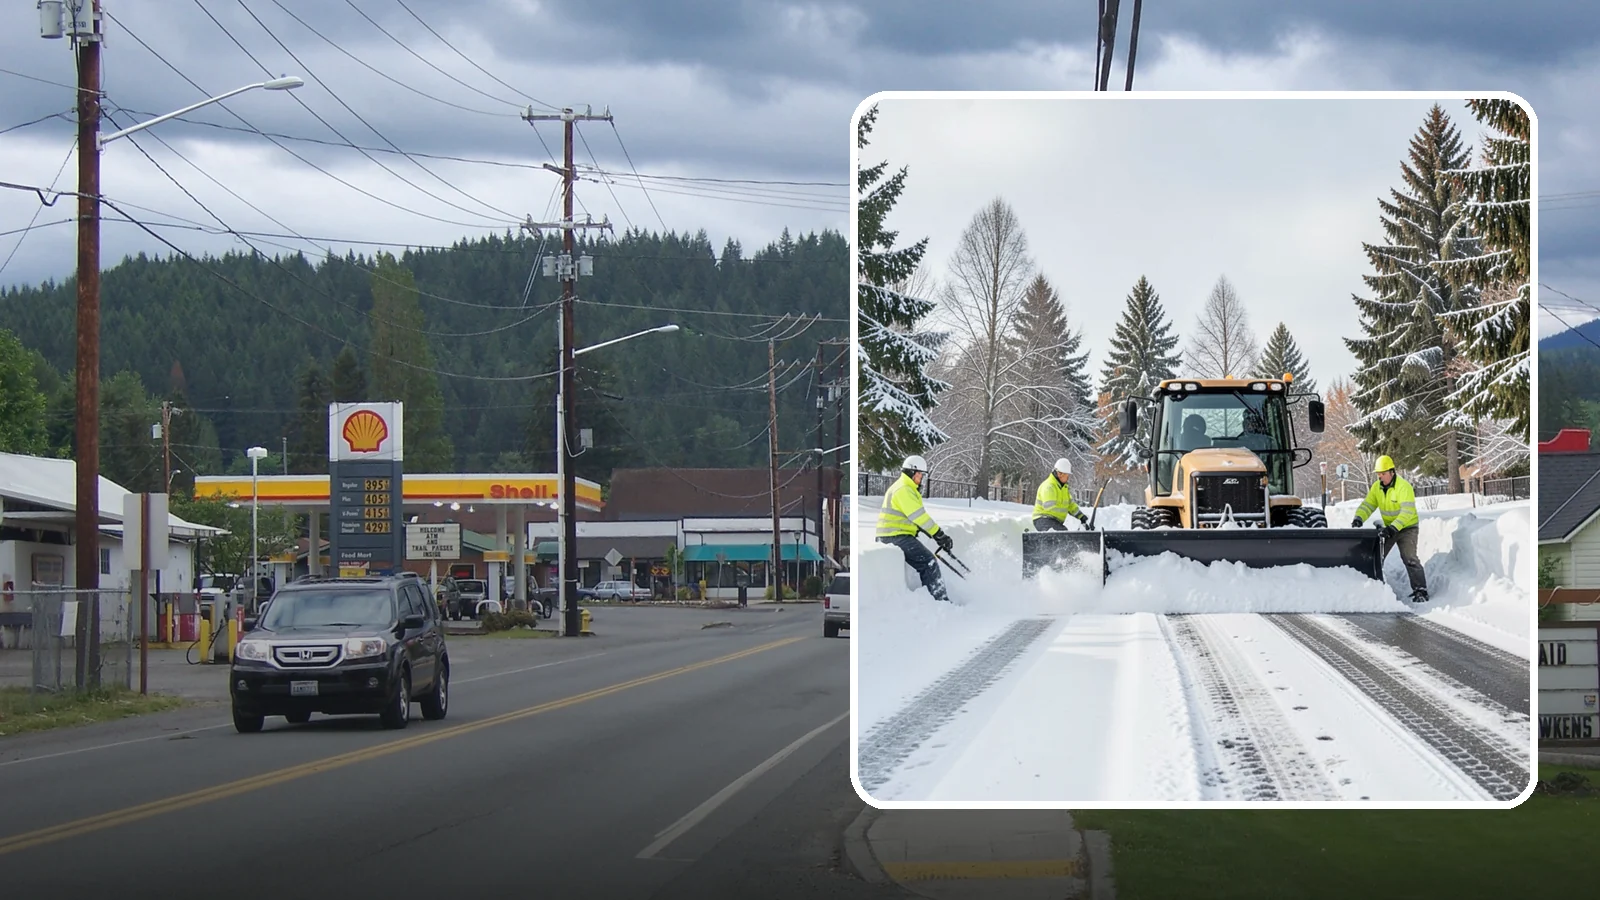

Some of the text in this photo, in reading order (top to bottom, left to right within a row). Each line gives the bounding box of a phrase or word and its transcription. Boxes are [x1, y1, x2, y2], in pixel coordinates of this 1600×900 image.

[366, 480, 383, 490] 395
[490, 484, 547, 499] Shell
[365, 494, 383, 504] 405
[365, 508, 383, 518] 415
[365, 522, 383, 533] 429
[1538, 642, 1567, 665] AID
[1538, 715, 1592, 738] WKENS
